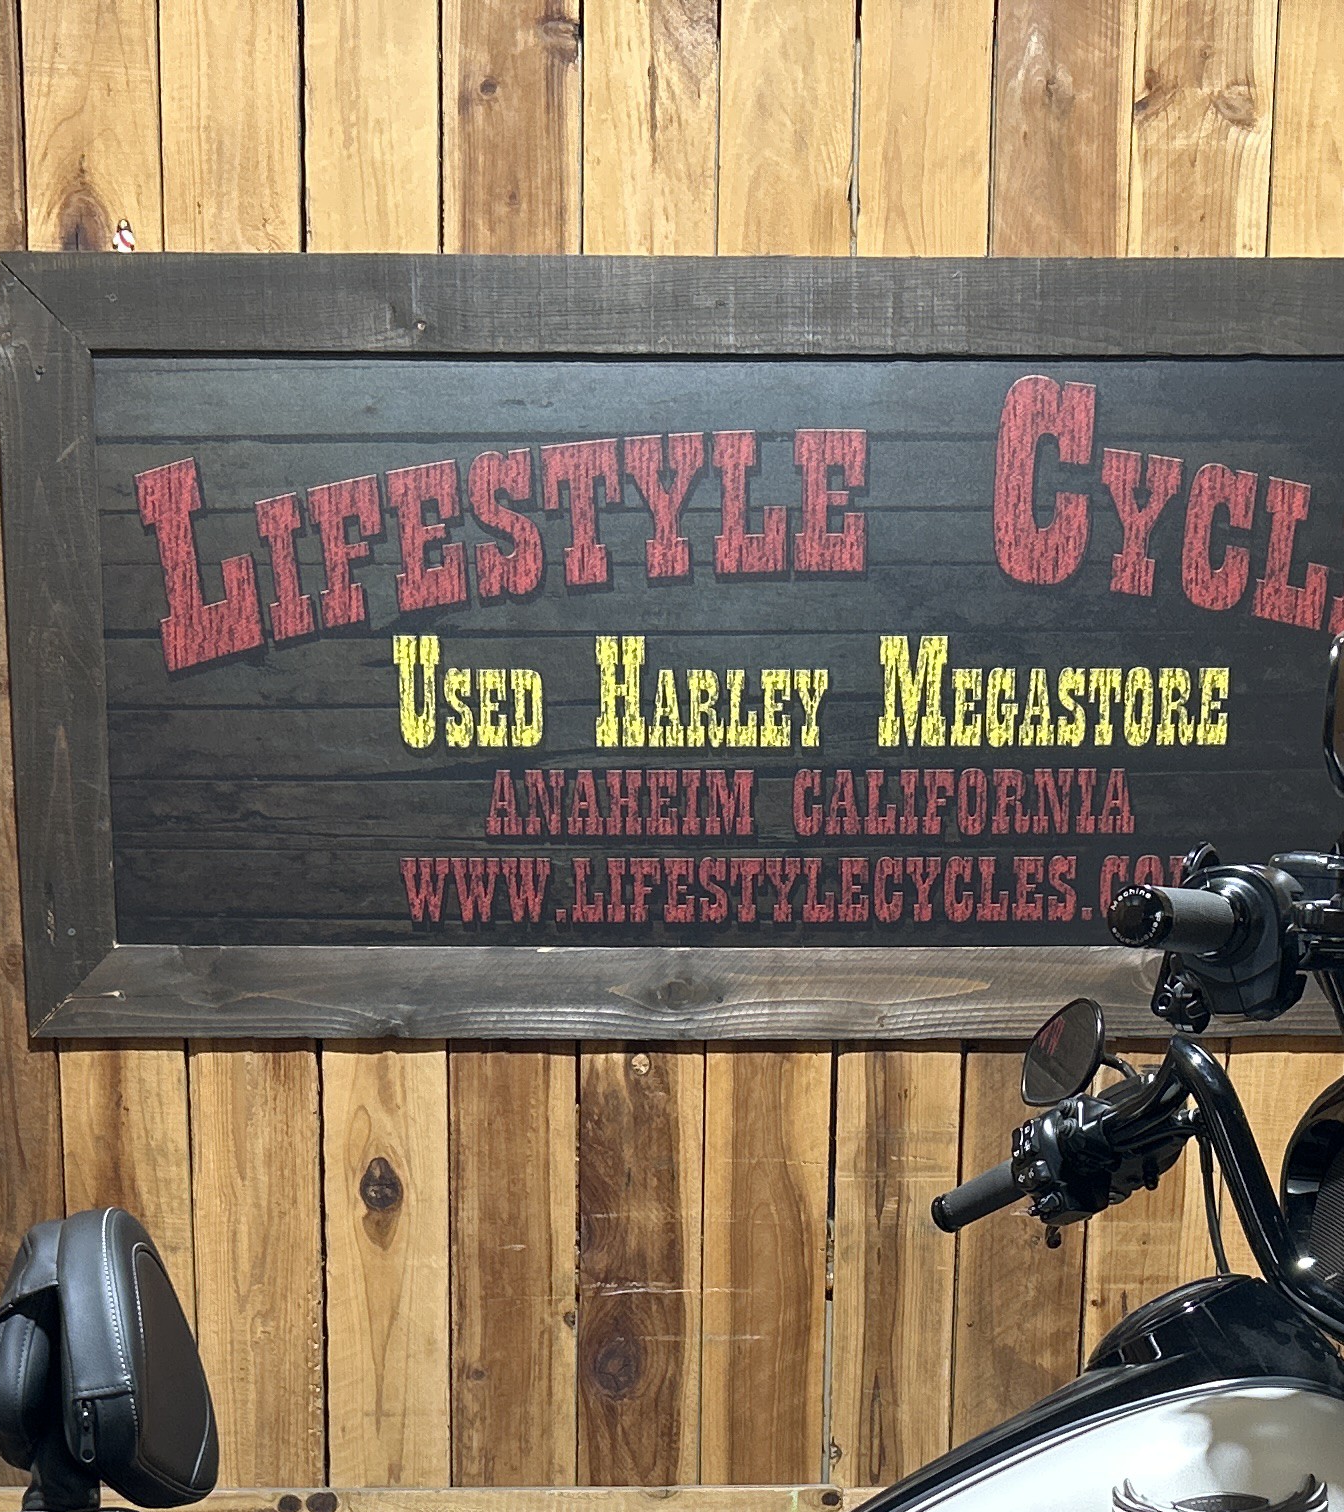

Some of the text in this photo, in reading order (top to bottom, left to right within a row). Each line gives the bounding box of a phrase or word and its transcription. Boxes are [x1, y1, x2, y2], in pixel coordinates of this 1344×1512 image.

[134, 428, 867, 671] LIFESTYLE
[392, 634, 1230, 749] USED HARLEY MEGASTORE
[485, 767, 1135, 836] ANAHEIM CALIFORNIA
